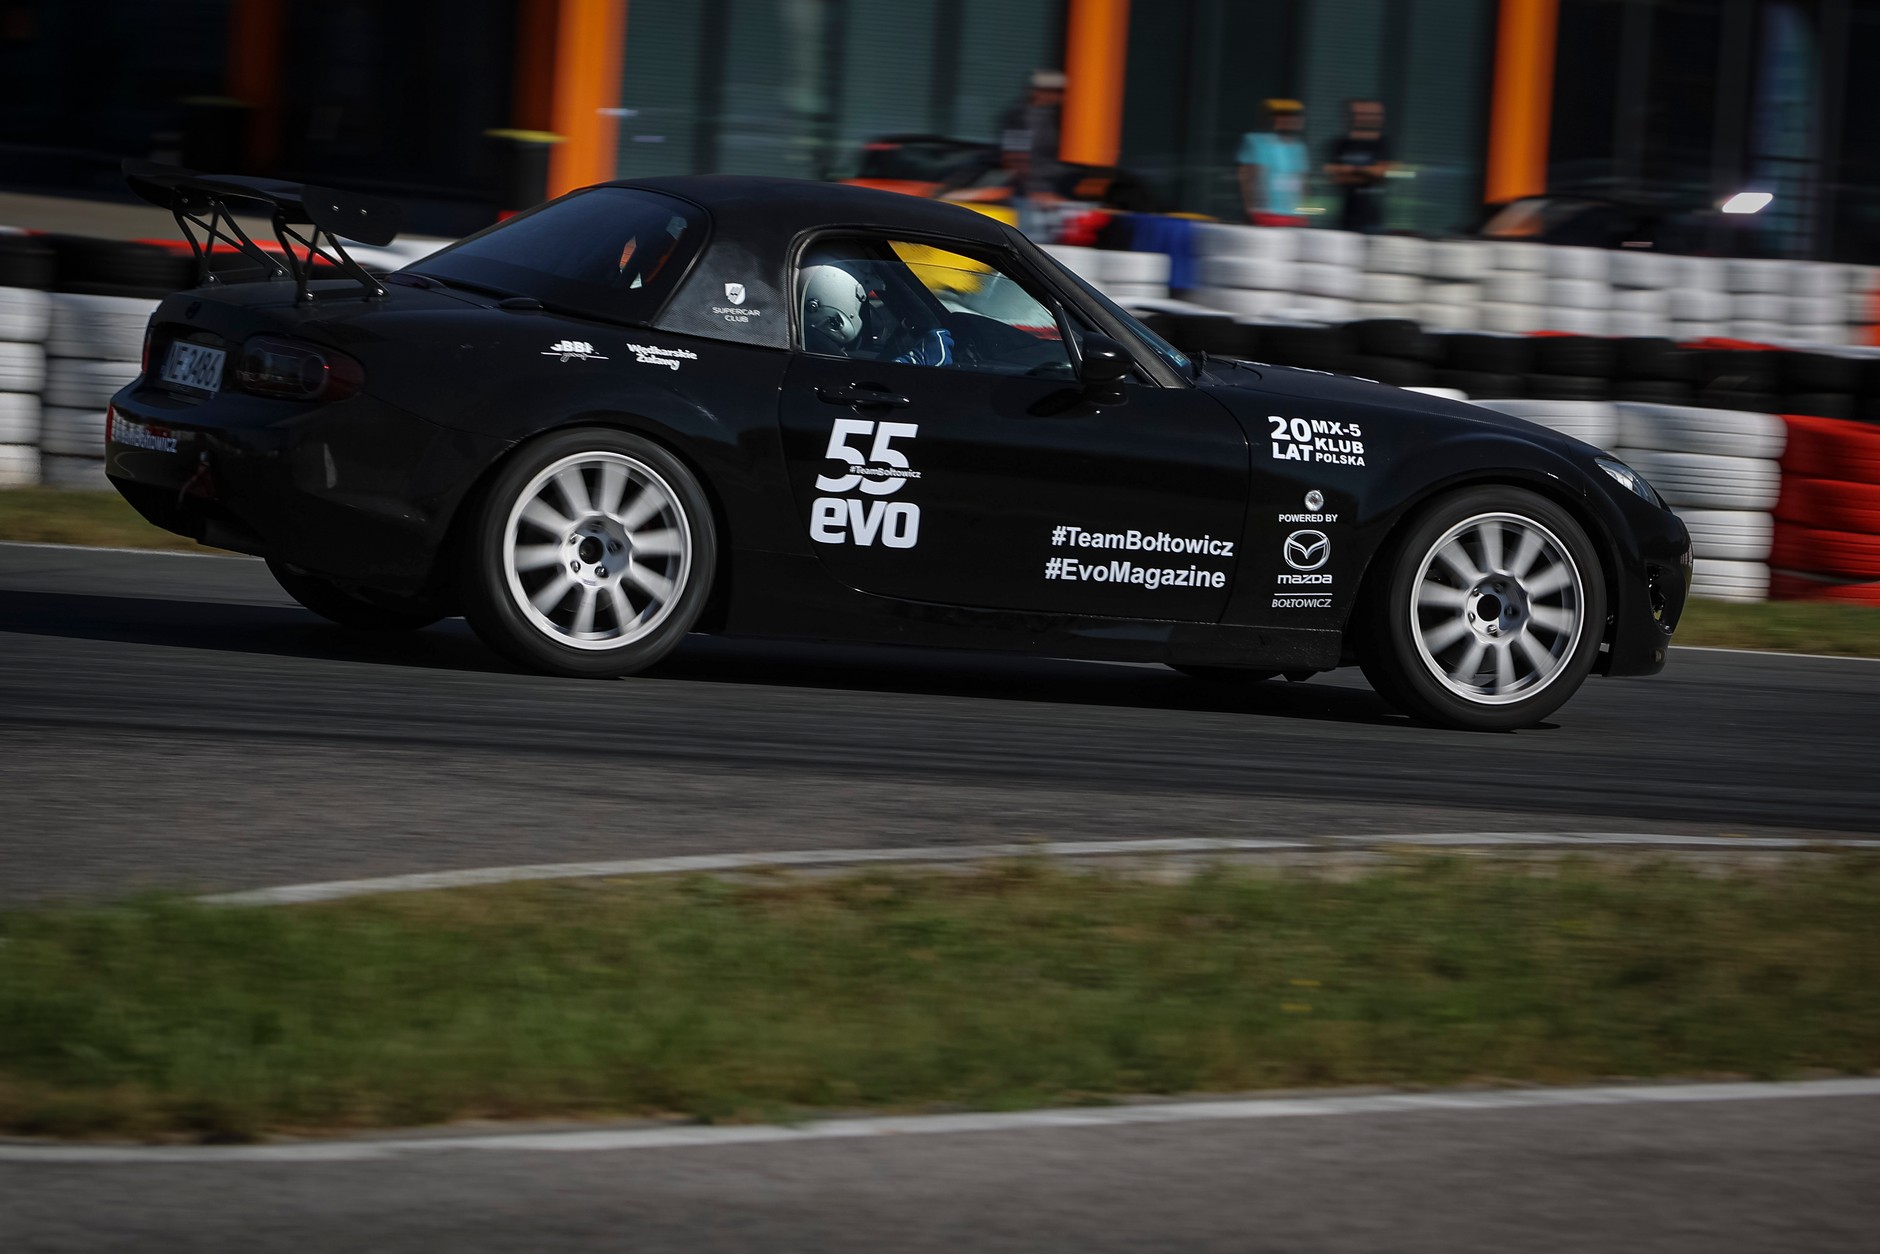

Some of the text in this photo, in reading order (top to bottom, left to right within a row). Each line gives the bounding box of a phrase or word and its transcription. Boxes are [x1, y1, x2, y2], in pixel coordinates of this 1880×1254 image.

[711, 307, 761, 317] SUPERCAR
[724, 315, 749, 323] CLUB
[1268, 416, 1311, 442] 20
[1311, 420, 1362, 437] MX-5
[1272, 442, 1313, 461] LAT
[1315, 437, 1365, 454] KLUB
[815, 419, 918, 495] 55
[1315, 452, 1366, 466] POLSKA
[810, 498, 920, 549] evo
[1278, 513, 1339, 522] POWERED BY
[1051, 525, 1234, 557] #TeamBołtowicz
[1045, 557, 1226, 590] #EvoMagazine
[1277, 574, 1333, 585] mazda
[1271, 598, 1332, 608] BOŁTOWICZ
